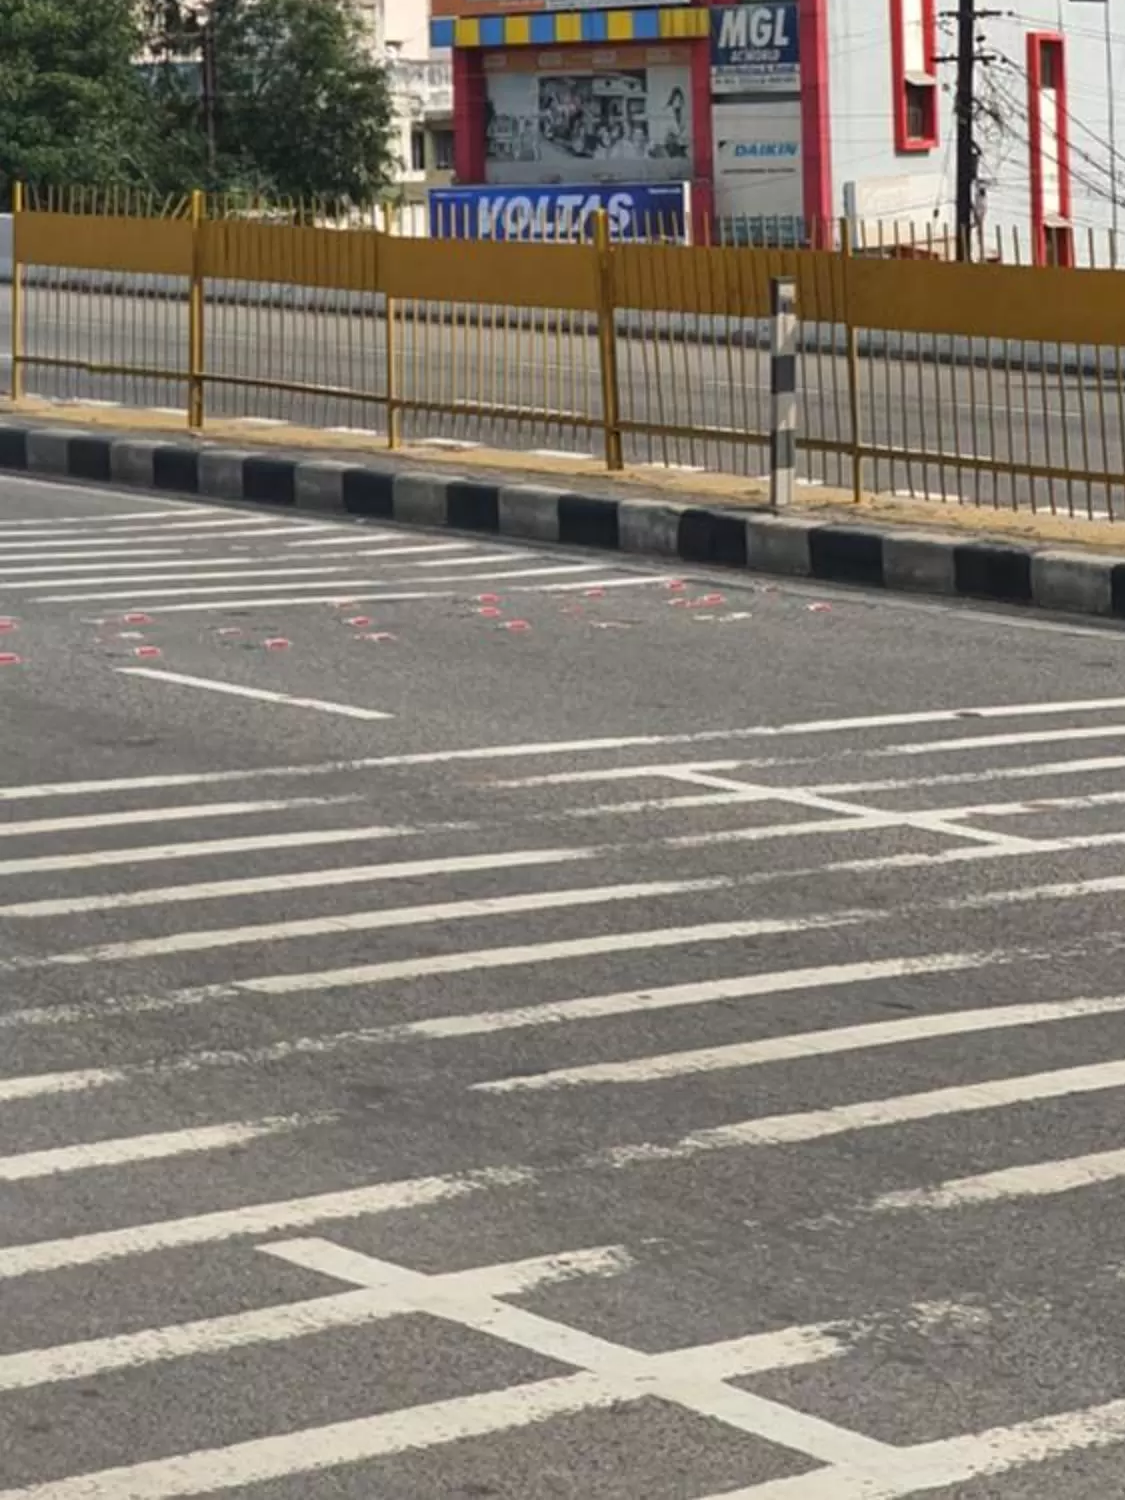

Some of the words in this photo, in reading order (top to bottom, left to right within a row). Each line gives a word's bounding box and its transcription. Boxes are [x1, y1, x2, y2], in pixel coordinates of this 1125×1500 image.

[718, 7, 789, 48] MGL
[735, 142, 798, 157] DAIKIN
[478, 192, 634, 235] VOLTAS
